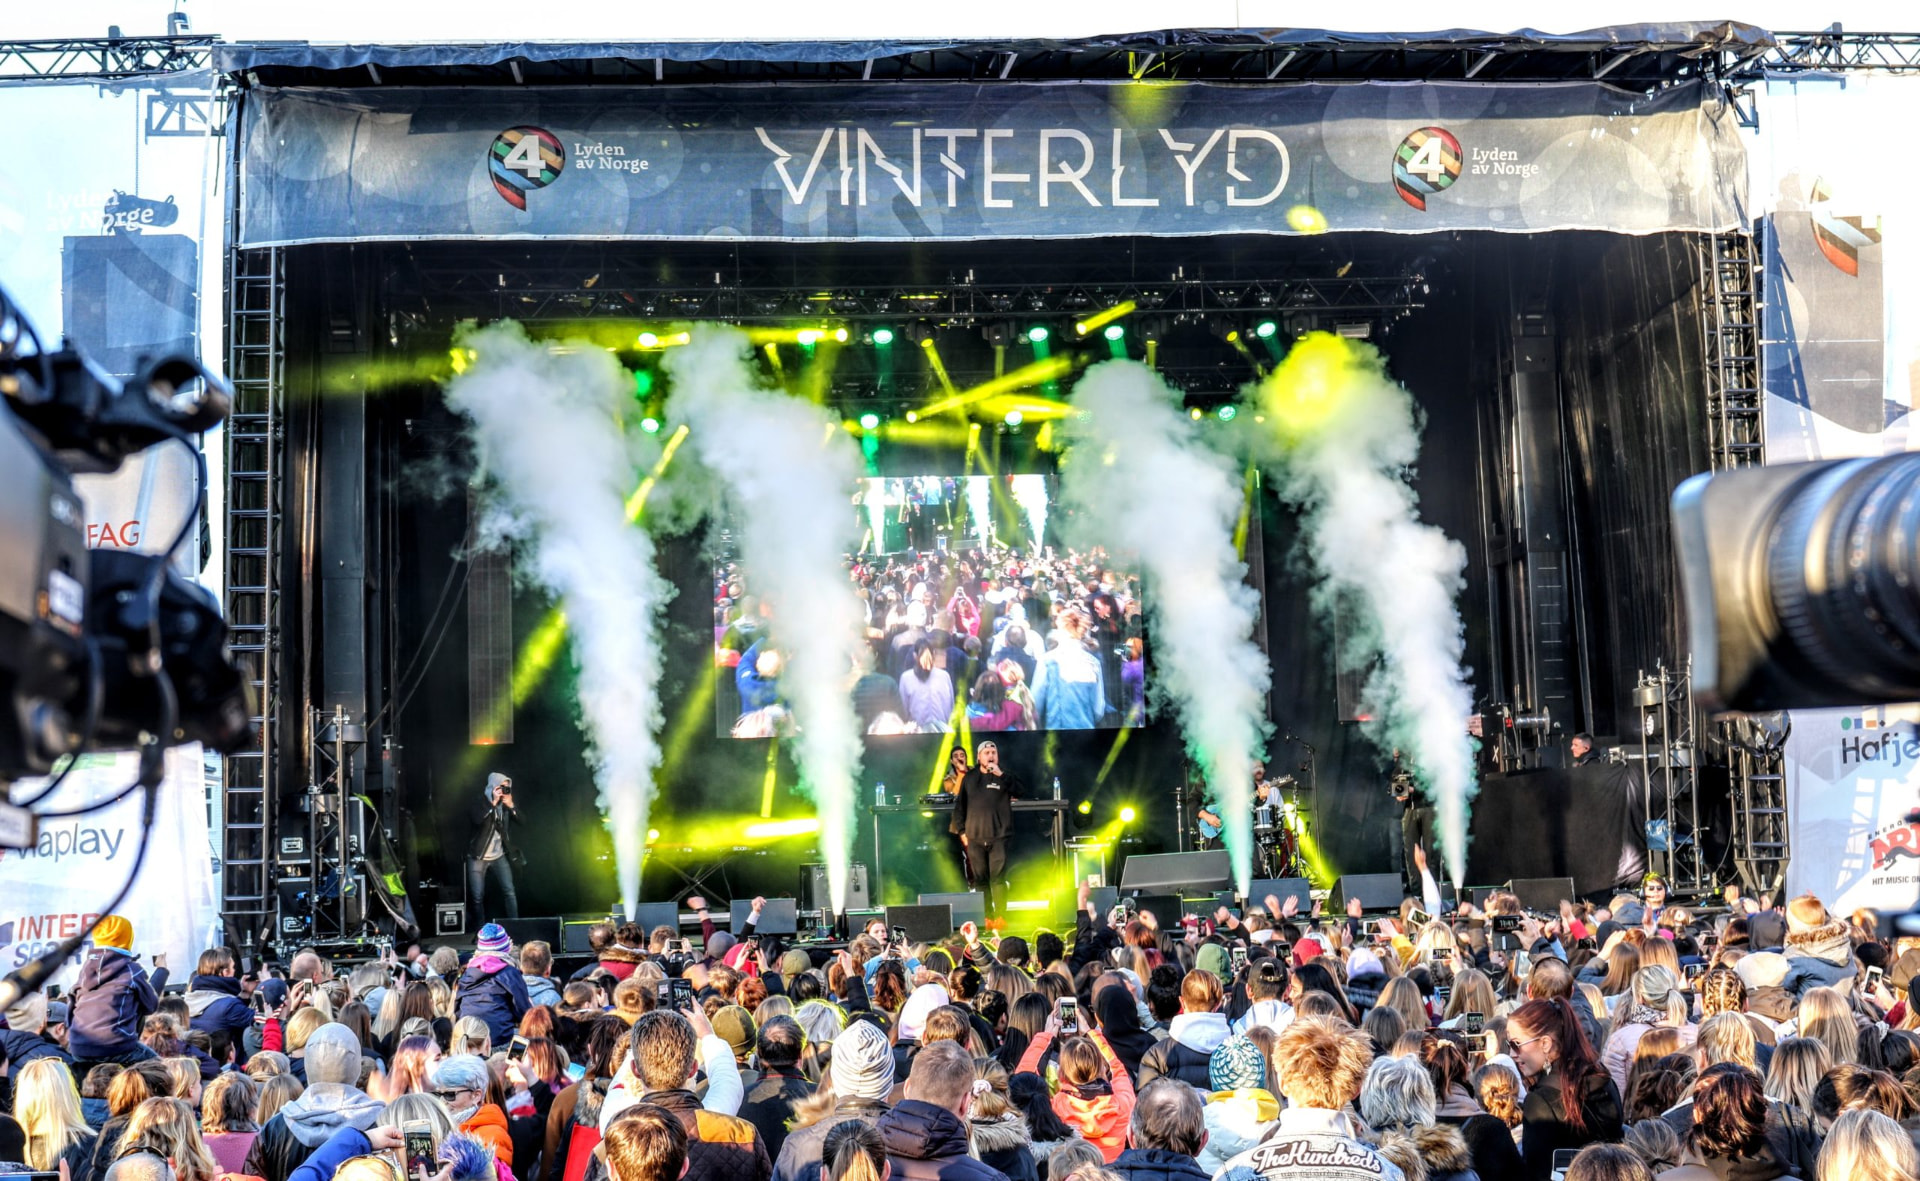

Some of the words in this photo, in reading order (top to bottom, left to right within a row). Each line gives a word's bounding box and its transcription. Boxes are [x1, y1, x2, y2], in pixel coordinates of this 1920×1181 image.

[504, 135, 546, 178] 4
[574, 143, 625, 160] Lyden
[1406, 137, 1445, 182] 4
[1472, 147, 1518, 163] Lyden
[575, 159, 595, 170] av
[599, 157, 649, 173] Norge
[754, 127, 1291, 208] VINTERLYD
[1471, 165, 1490, 175] av
[1493, 162, 1539, 178] Norge
[79, 207, 154, 231] Norge
[87, 520, 140, 548] FAG
[19, 823, 124, 862] aplay
[1886, 876, 1909, 885] MUSIC
